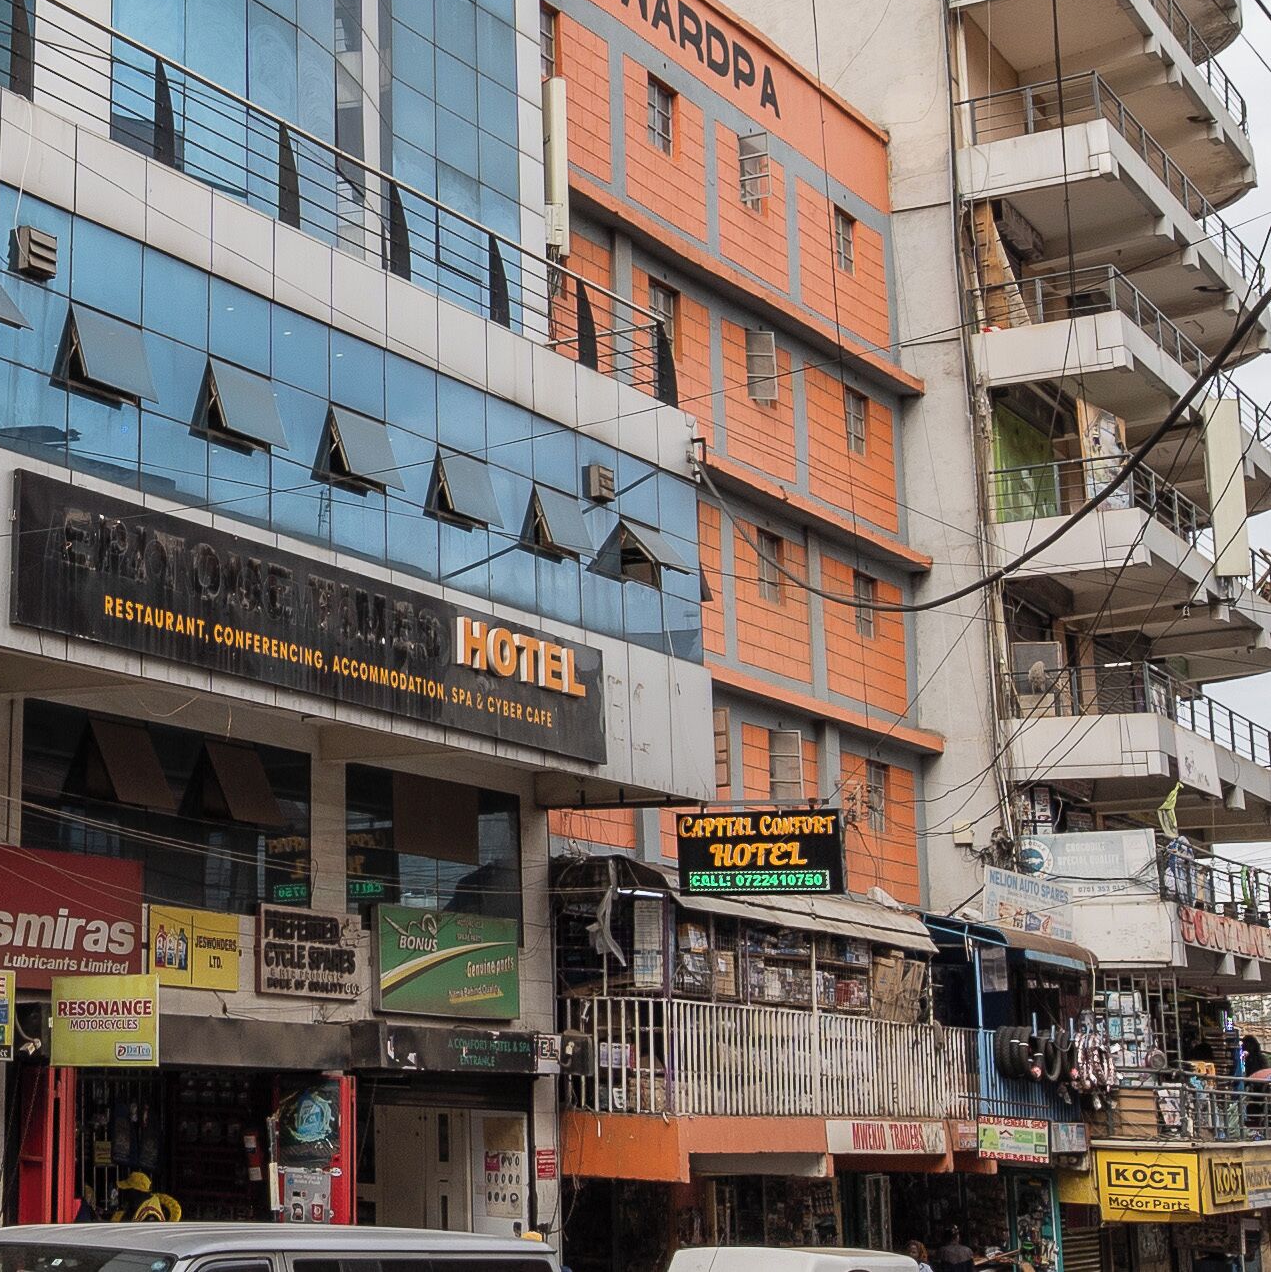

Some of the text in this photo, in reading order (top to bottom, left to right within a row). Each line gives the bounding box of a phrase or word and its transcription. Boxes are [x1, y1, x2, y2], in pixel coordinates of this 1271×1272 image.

[104, 594, 553, 728] RESTAURANT, CONFERENCING, ACCOMMODATION, SPA & CYBER CAFE
[456, 615, 587, 697] HOTEL
[708, 841, 809, 868] HOTEL
[734, 873, 824, 887] 0722410750
[1019, 878, 1040, 896] AUTO
[1041, 885, 1069, 905] SPARES
[399, 935, 439, 952] BONUS
[3, 952, 129, 975] Lubricants Limited
[208, 955, 224, 970] LTD.
[264, 941, 307, 970] CYCLE
[466, 960, 496, 978] Genuine
[56, 998, 153, 1018] RESONANCE
[69, 1017, 139, 1032] MOTORCYCLES
[979, 1150, 1049, 1164] BASEMENT
[1114, 1168, 1181, 1184] KOCT
[1214, 1167, 1243, 1195] KOCT
[1109, 1196, 1190, 1210] Motor Parts
